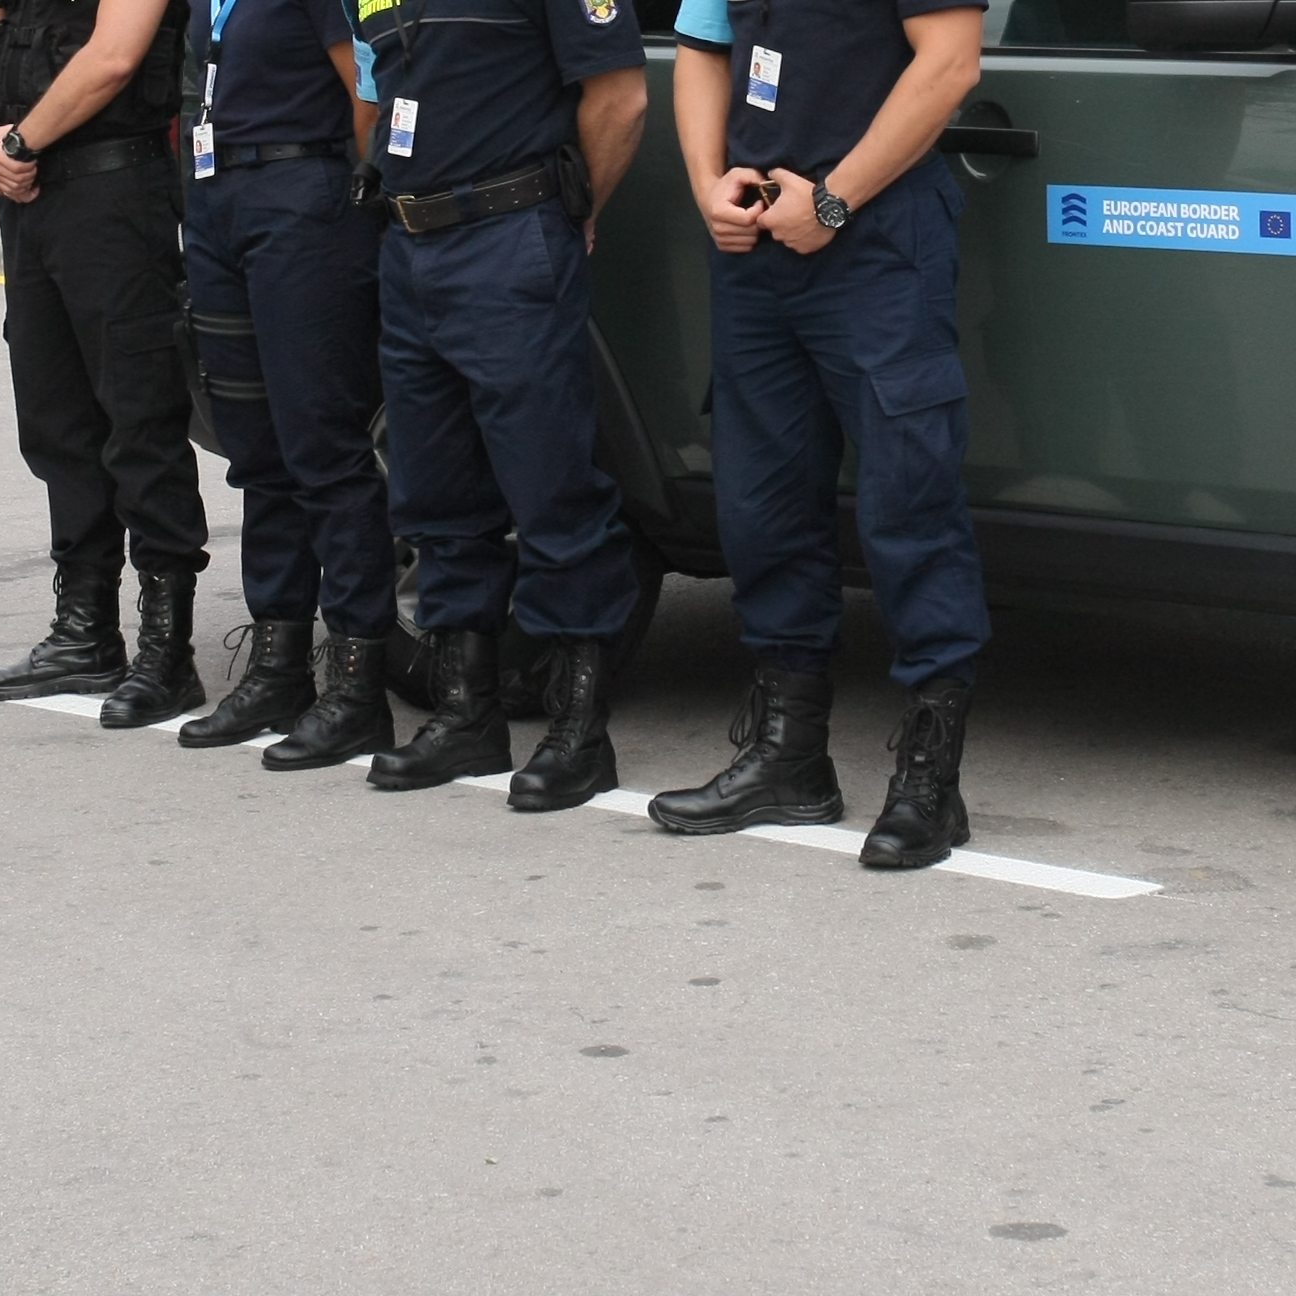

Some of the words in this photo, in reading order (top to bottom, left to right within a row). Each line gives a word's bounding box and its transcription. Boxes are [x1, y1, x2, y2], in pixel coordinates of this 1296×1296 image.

[1102, 199, 1178, 218] EUROPEAN
[1180, 204, 1240, 222] BORDER
[1102, 219, 1134, 235] AND
[1136, 221, 1185, 238] COAST
[1189, 223, 1240, 240] GUARD
